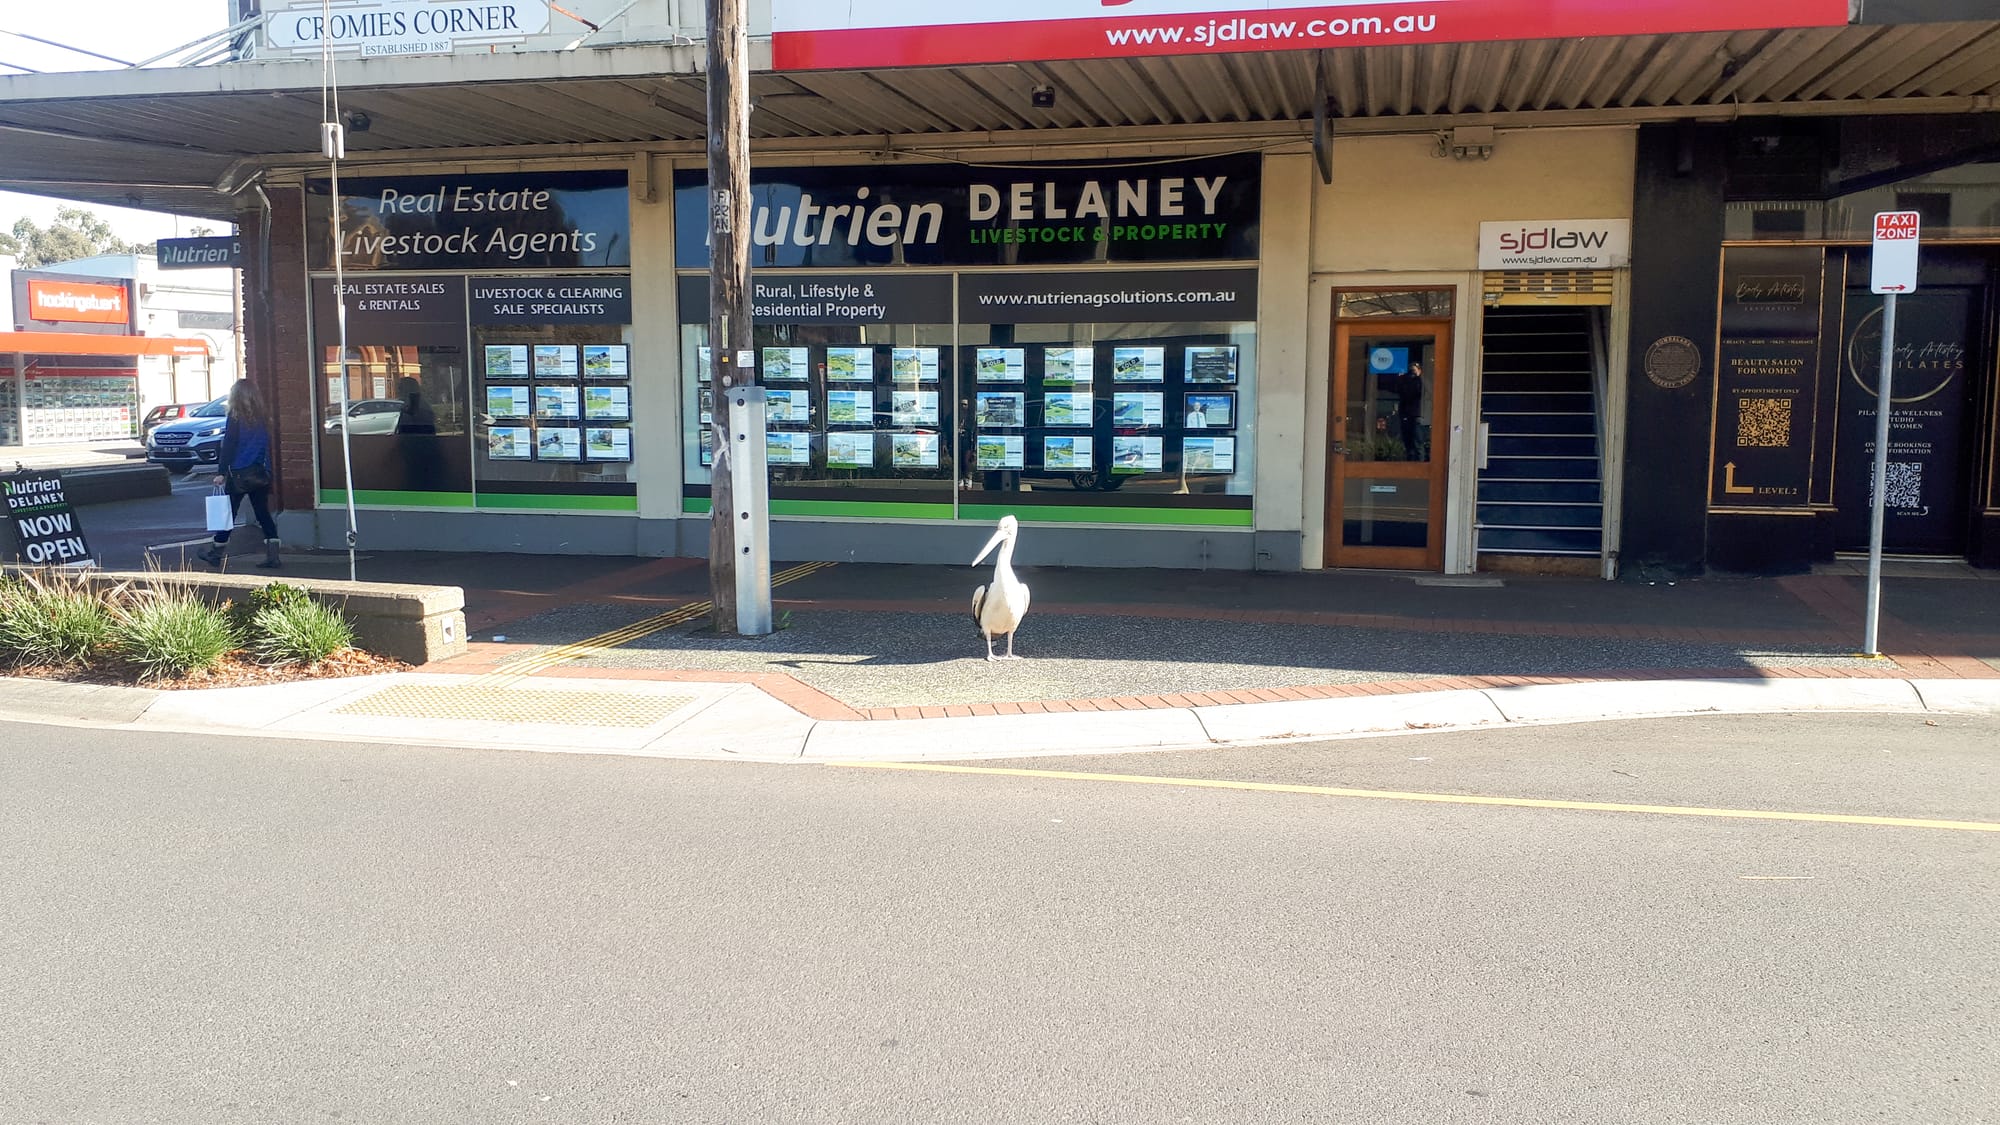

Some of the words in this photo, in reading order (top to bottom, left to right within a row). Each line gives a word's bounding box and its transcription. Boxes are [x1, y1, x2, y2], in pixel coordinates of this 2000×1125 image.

[296, 11, 406, 40] CROMIES
[413, 4, 518, 34] CORNER
[1105, 14, 1437, 47] www.sjdlaw.com.au
[365, 43, 428, 55] ESTABLISHED
[430, 42, 448, 52] 1887
[379, 186, 446, 213] Real
[453, 186, 550, 212] Estate
[969, 176, 1228, 220] DELANEY
[705, 186, 943, 247] utrien
[1880, 215, 1914, 227] TAXI
[970, 226, 1086, 245] LIVESTOCK
[1092, 224, 1107, 242] &
[1113, 222, 1228, 242] PROPERTY
[1500, 228, 1608, 254] sjdlaw
[1877, 227, 1916, 239] ZONE
[340, 227, 480, 256] Livestock
[485, 227, 597, 259] Agents
[163, 244, 228, 263] Nutrien
[1502, 255, 1597, 265] www.sjdlaw.com.au
[333, 284, 362, 295] REAL
[365, 284, 408, 294] ESTATE
[410, 283, 445, 294] SALES
[475, 288, 543, 299] LIVESTOCK
[547, 288, 556, 299] &
[560, 287, 623, 299] CLEARING
[755, 284, 796, 299] Rural,
[800, 284, 859, 300] Lifestyle
[863, 283, 875, 298] &
[358, 300, 367, 310] &
[369, 300, 421, 310] RENTALS
[979, 290, 1236, 308] www.nutrienagsolutions.com.au
[494, 304, 525, 315] SALE
[531, 303, 605, 315] SPECIALISTS
[826, 302, 886, 319] Property
[1737, 367, 1757, 375] FOR
[1760, 367, 1797, 375] WOMEN
[1898, 361, 1964, 369] ILATES
[2, 477, 61, 496] Nutrien
[1759, 487, 1790, 495] LEVEL
[1791, 487, 1798, 495] 2
[8, 492, 65, 508] DELANEY
[19, 513, 72, 538] NOW
[27, 536, 87, 563] OPEN
